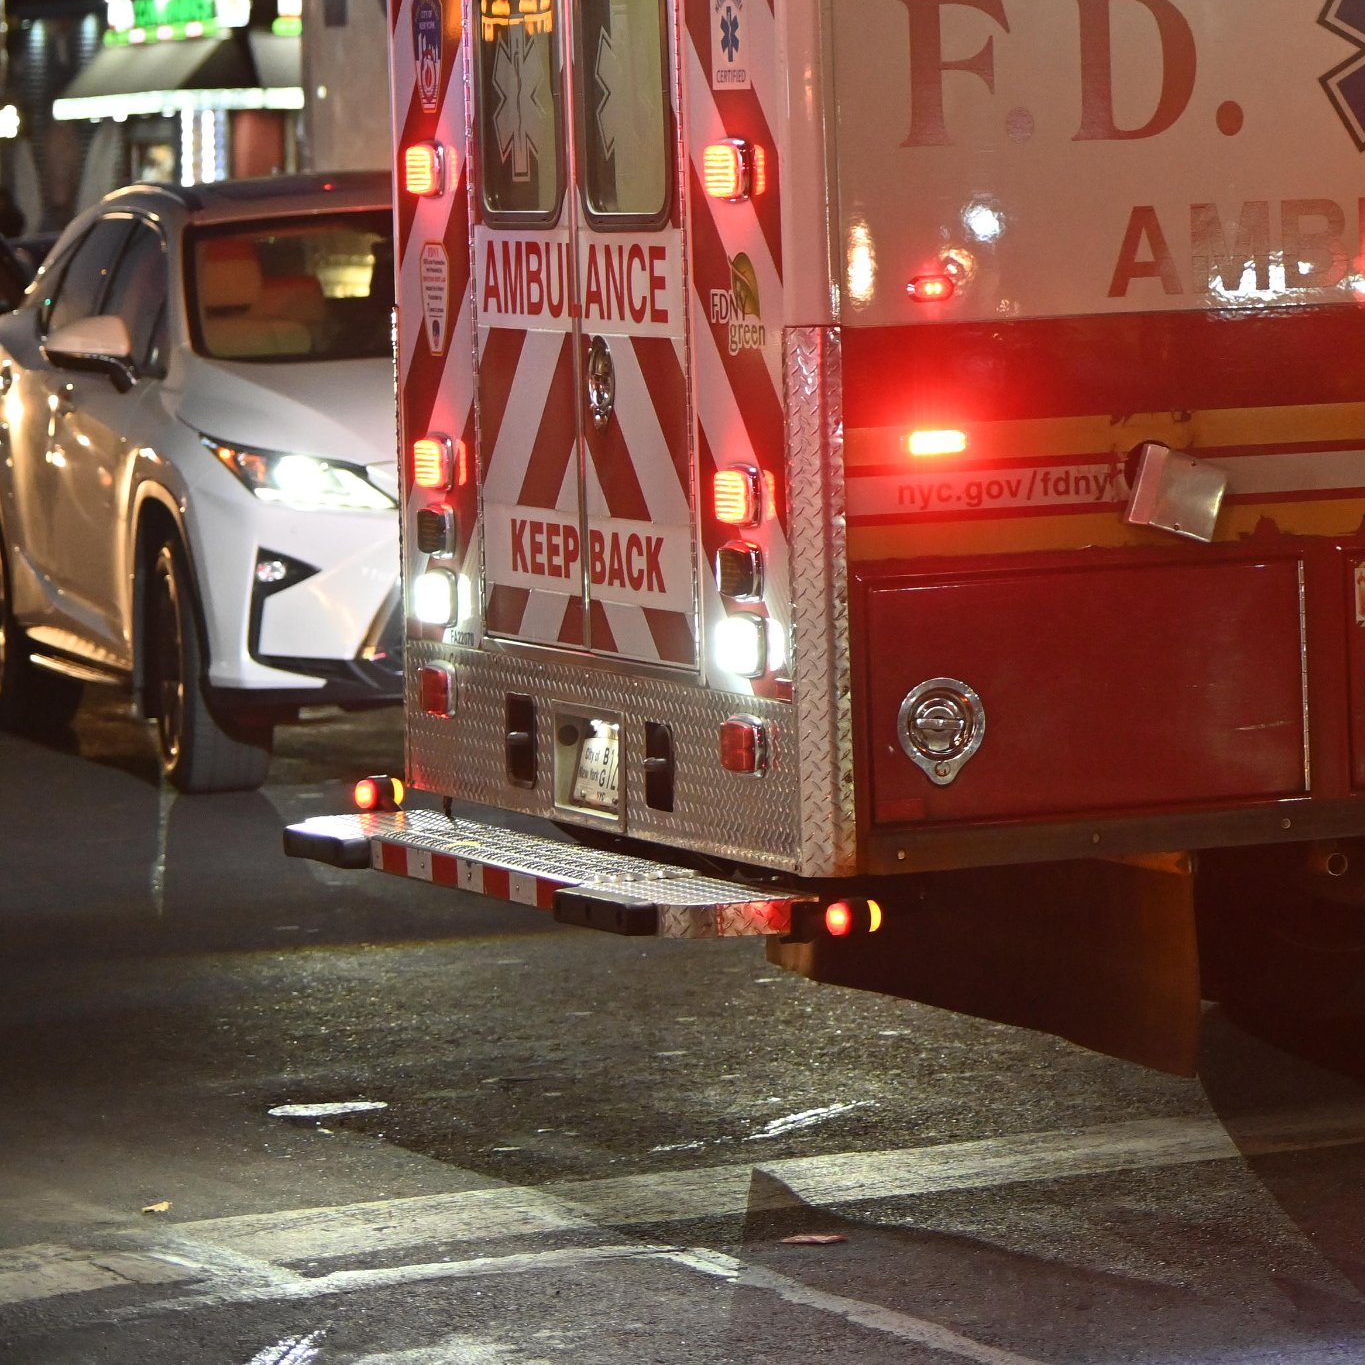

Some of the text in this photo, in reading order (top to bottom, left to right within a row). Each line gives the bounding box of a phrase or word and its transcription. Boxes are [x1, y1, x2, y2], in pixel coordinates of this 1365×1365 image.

[716, 69, 747, 83] CERTIFIED
[482, 240, 669, 324] AMBULANCE
[710, 287, 747, 326] FDNY
[729, 321, 766, 356] green
[897, 469, 1111, 510] nyc.gov/fdny
[509, 517, 667, 594] KEEP BACK
